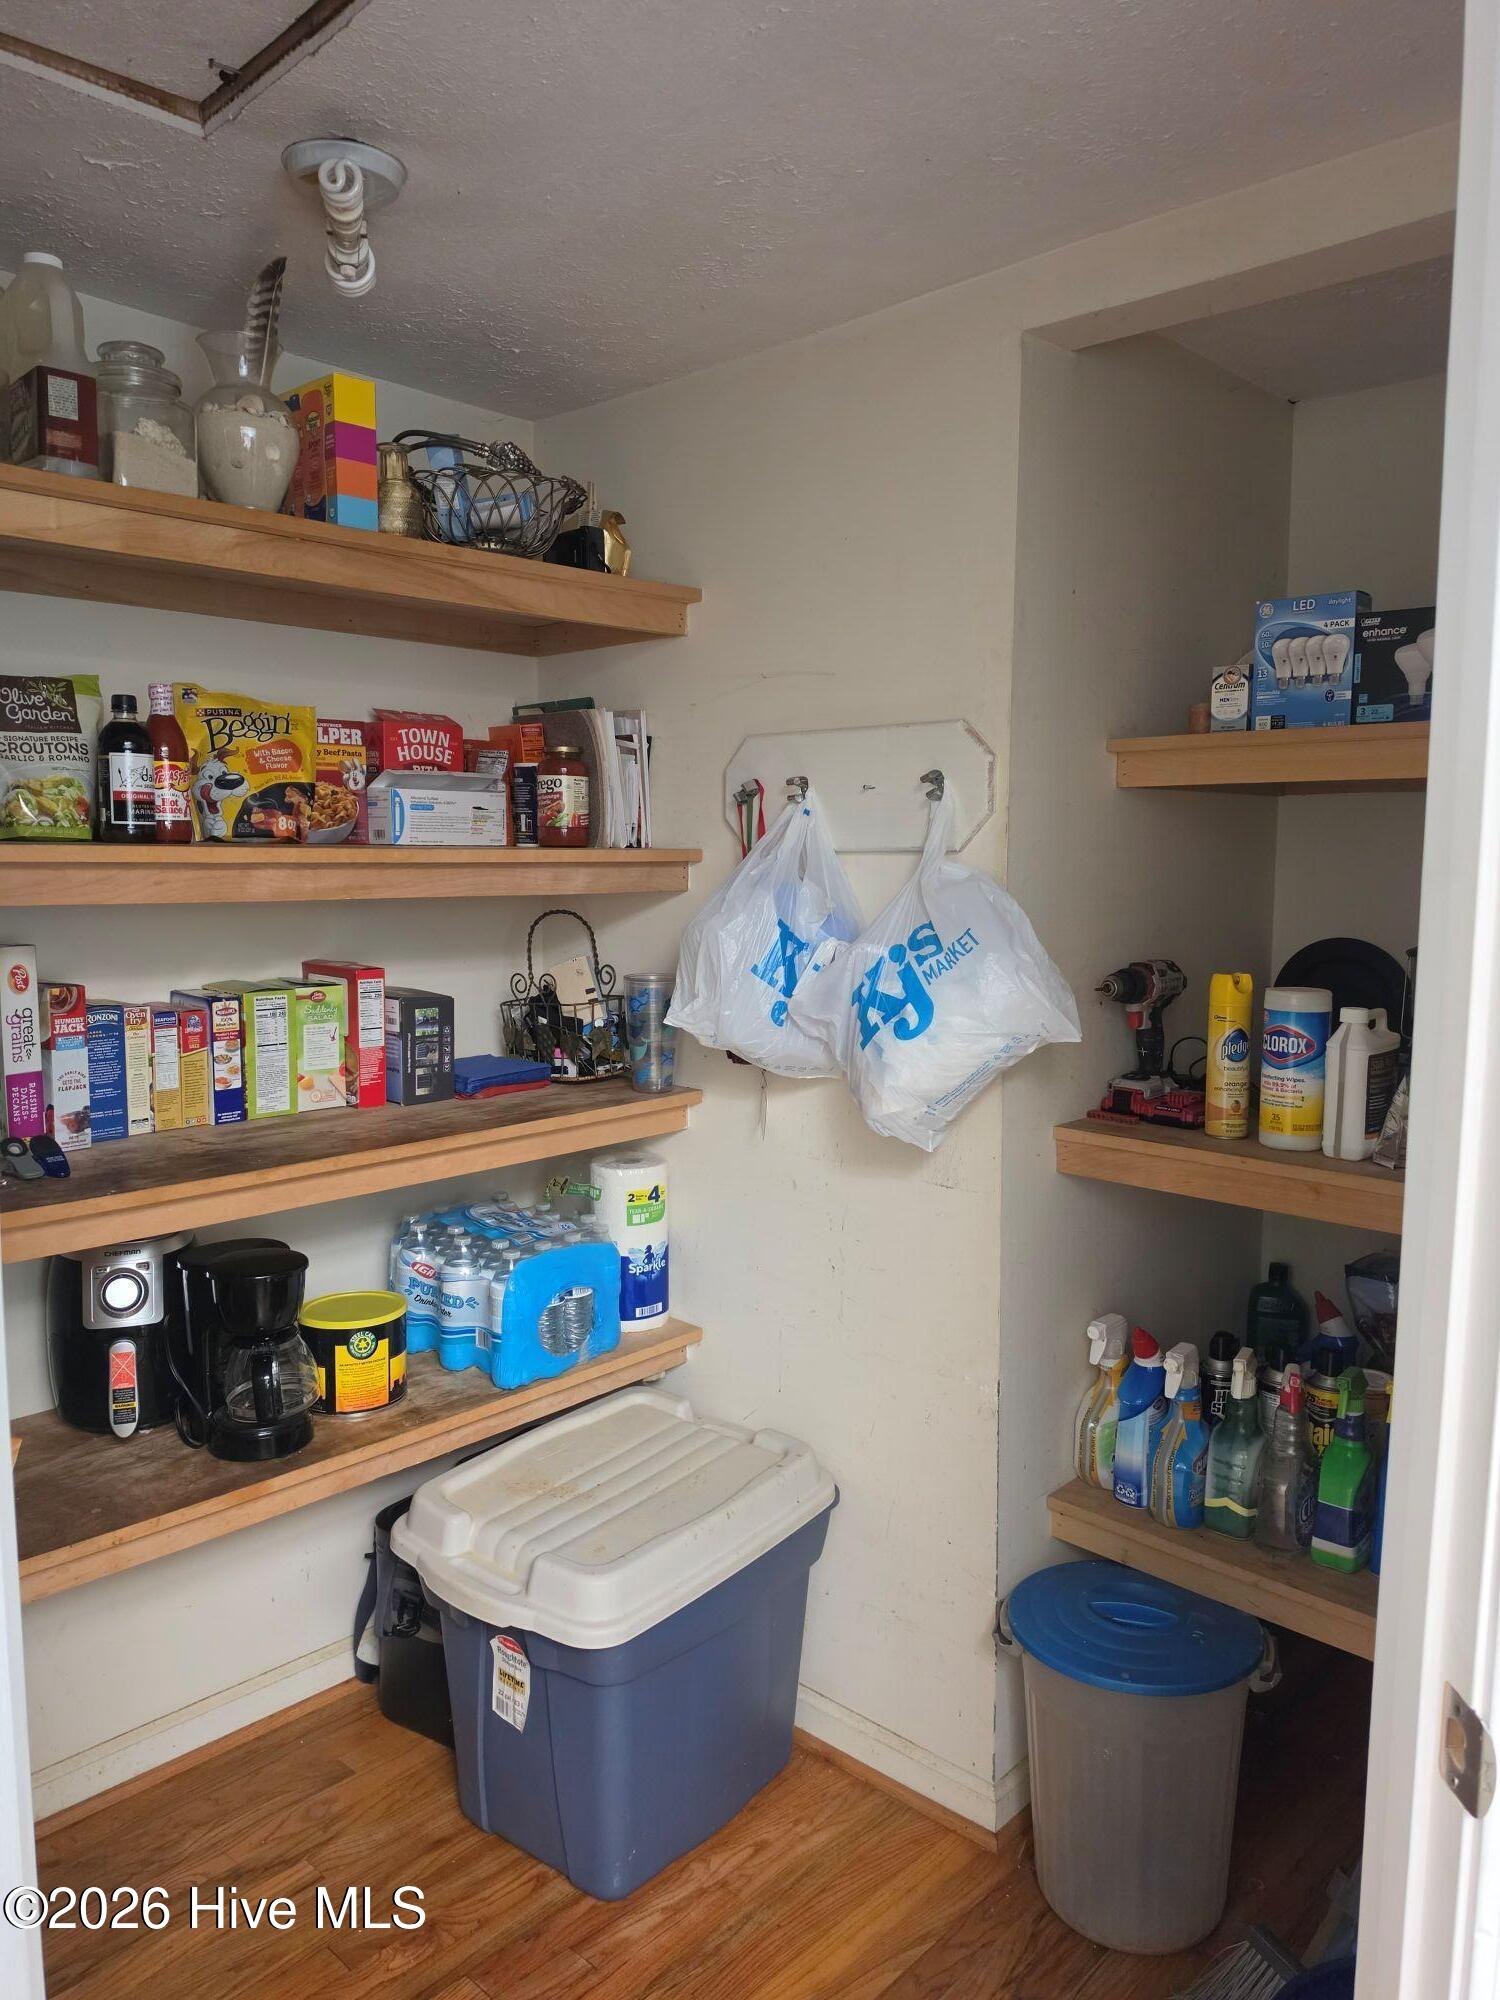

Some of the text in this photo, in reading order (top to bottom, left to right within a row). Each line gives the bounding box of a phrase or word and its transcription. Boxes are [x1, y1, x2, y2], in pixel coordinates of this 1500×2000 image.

[1293, 599, 1316, 611] LED
[1330, 619, 1351, 628] PACK
[1362, 626, 1407, 638] enhance
[0, 687, 45, 706] Olive
[6, 703, 75, 724] Garden
[4, 735, 79, 743] SIGNATURE RECIPE
[398, 727, 450, 747] TOWN
[0, 741, 89, 756] CROUTONS
[271, 748, 294, 756] Bacon
[323, 748, 341, 756] Beef
[341, 749, 362, 757] Pasta
[396, 744, 453, 765] HOUSE
[38, 754, 45, 762] &
[48, 754, 90, 763] ROMANO
[161, 797, 179, 807] Hot
[154, 805, 184, 815] Sauce
[921, 927, 980, 986] MARKET
[13, 967, 27, 992] Post
[54, 1016, 85, 1026] HUNGRY
[86, 1013, 119, 1025] RONZONI
[22, 1008, 36, 1048] great
[53, 1023, 87, 1034] JACK
[6, 1009, 24, 1063] grains
[1262, 1034, 1307, 1054] CLOROX
[20, 1087, 29, 1116] DATES
[1271, 1113, 1281, 1121] 35
[627, 1185, 661, 1203] 2 4
[103, 1249, 142, 1257] CHEFMAN
[413, 1263, 436, 1276] IGA
[628, 1257, 666, 1276] Sparkle
[498, 1669, 525, 1689] LIFETIME
[497, 1688, 505, 1696] 22
